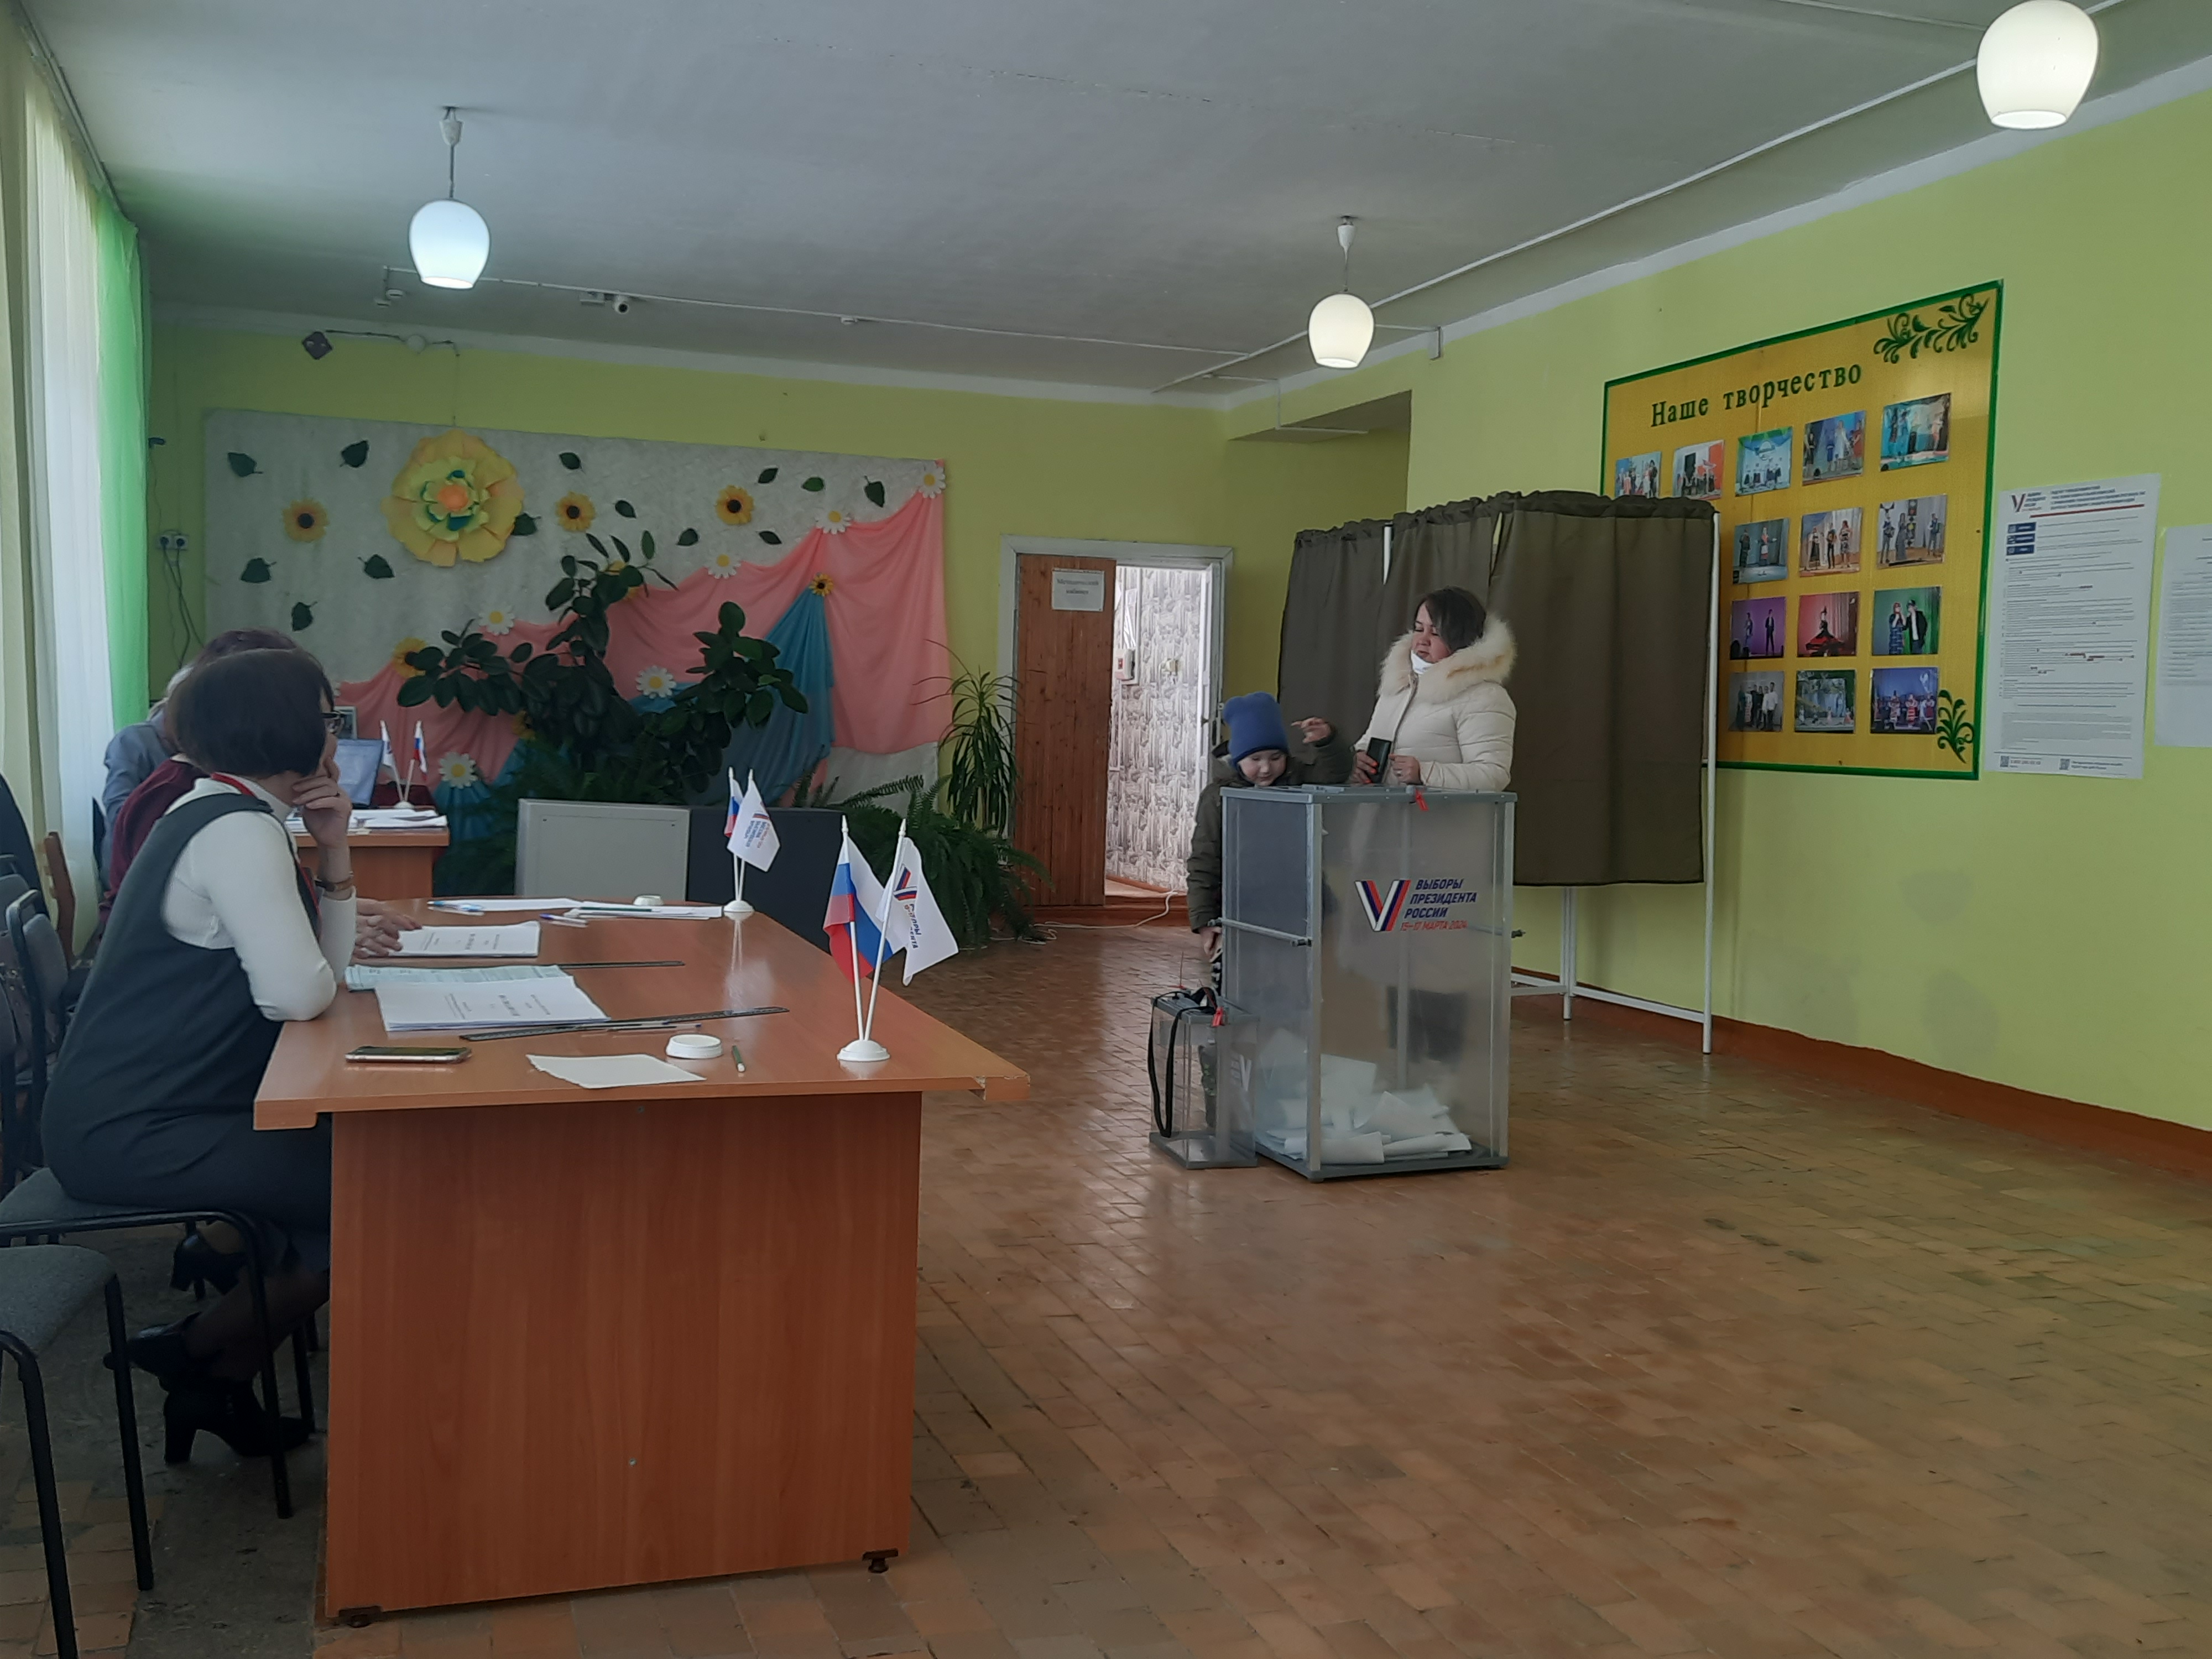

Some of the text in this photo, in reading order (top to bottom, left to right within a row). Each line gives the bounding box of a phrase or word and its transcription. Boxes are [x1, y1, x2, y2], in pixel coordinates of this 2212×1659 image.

[1651, 364, 1861, 427] Наше творчество
[1415, 878, 1464, 890] ВЫБОРЫ
[1410, 892, 1478, 905] ПРЕЗИДЕНТА
[1404, 907, 1449, 919] РОССИИ
[1423, 920, 1447, 930] МАРТА
